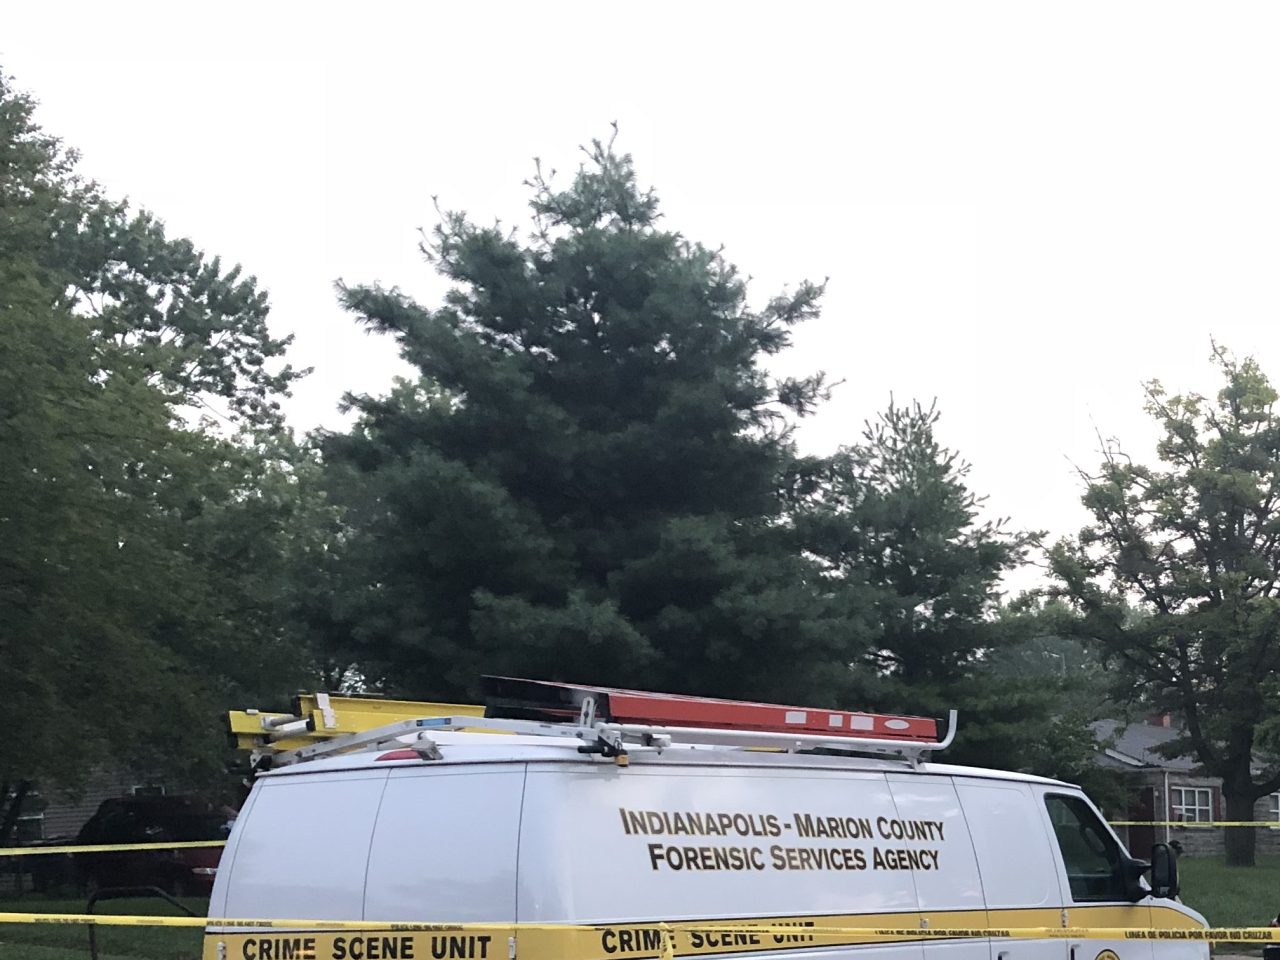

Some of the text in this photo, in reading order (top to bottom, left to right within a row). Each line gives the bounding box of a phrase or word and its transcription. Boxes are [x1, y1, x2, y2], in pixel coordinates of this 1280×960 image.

[619, 808, 782, 837] INDIANAPOLIS
[793, 813, 874, 839] MARION
[876, 816, 945, 841] COUNTY
[648, 843, 939, 871] FORENSIC SERVICES AGENCY
[243, 936, 491, 960] CRIME SCENE UNIT
[602, 929, 677, 953] CRIM
